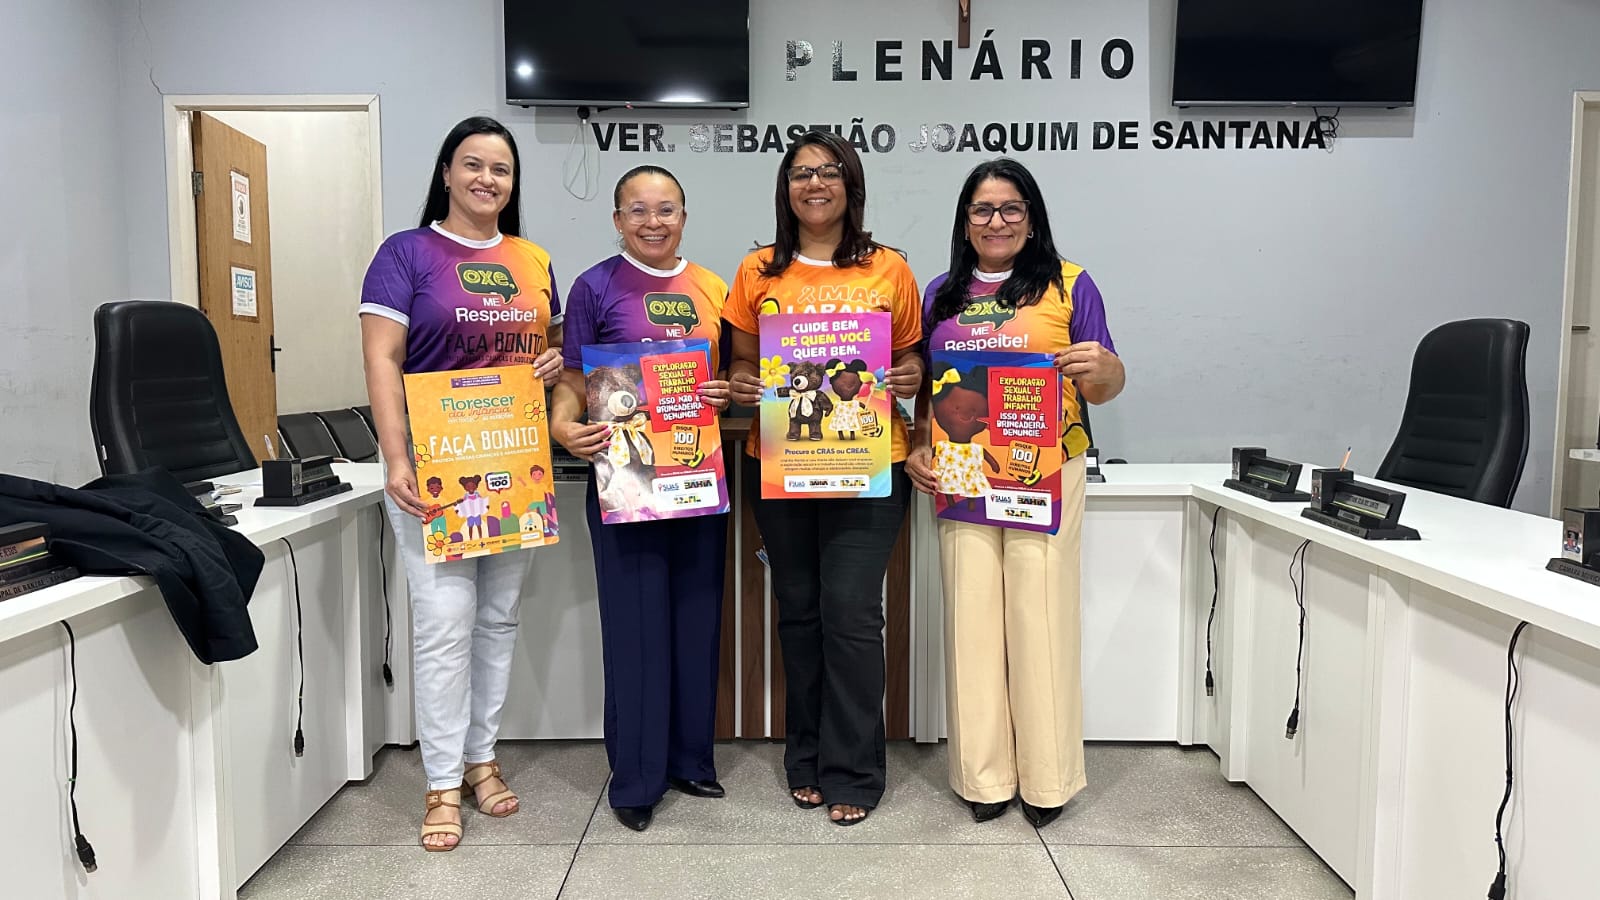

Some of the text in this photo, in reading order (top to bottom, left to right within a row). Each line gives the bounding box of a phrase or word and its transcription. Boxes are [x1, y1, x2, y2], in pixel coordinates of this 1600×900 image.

[785, 30, 1134, 81] PLENÁRIO
[592, 123, 675, 152] VER.
[908, 121, 1078, 155] JOAQUIM
[1093, 121, 1139, 150] DE
[1152, 120, 1326, 150] SANTANA
[482, 297, 501, 307] ME
[455, 307, 537, 327] Respeite!
[792, 320, 859, 334] CUIDE BEM
[971, 326, 990, 337] ME
[665, 328, 682, 338] ME
[781, 328, 871, 347] DE QUEM VOCÊ
[445, 331, 544, 355] FAÇA BONITO
[944, 333, 1029, 352] Respeite!
[793, 344, 860, 360] QUER BEM.
[653, 361, 697, 372] EXPLORAÇÃO
[659, 370, 686, 379] SEXUAL
[659, 377, 696, 387] TRABALHO
[999, 376, 1046, 387] EXPLORAÇÃO
[661, 385, 695, 394] INFANTIL.
[1004, 385, 1041, 395] SEXUAL E
[440, 395, 515, 412] Florescer
[659, 397, 676, 405] ISSO
[1002, 393, 1042, 403] TRABALHO
[656, 402, 705, 413] BRINCADEIRA.
[1003, 402, 1041, 411] INFANTIL.
[663, 410, 701, 420] DENUNCIE.
[1000, 412, 1017, 420] ISSO
[1020, 413, 1036, 421] NÃO
[996, 419, 1049, 430] BRINCADEIRA.
[674, 431, 694, 444] 100
[1003, 428, 1043, 437] DENUNCIE.
[429, 426, 539, 457] FAÇA BONITO
[1011, 448, 1033, 463] 100
[490, 480, 508, 488] 100
